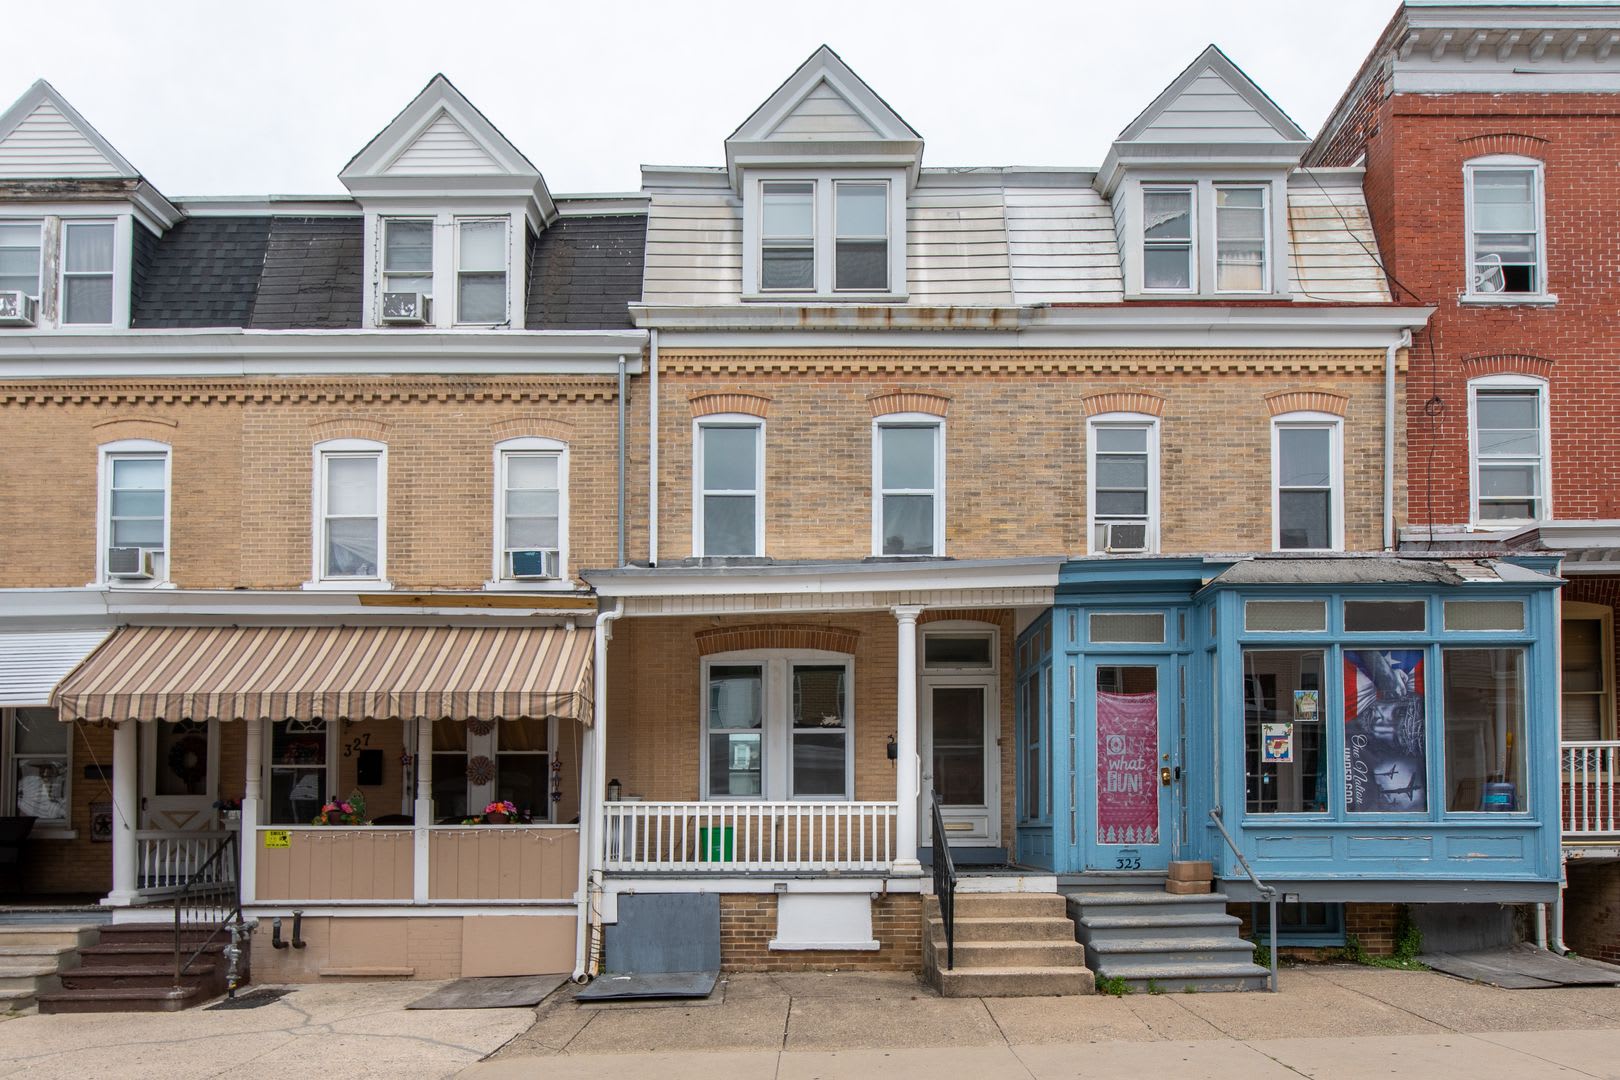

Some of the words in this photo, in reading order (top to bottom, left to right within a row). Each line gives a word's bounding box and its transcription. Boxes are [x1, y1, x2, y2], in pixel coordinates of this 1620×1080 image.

[344, 733, 371, 757] 327
[1352, 735, 1367, 757] One
[1109, 756, 1146, 770] what
[1354, 761, 1368, 803] Nation
[1115, 857, 1141, 870] 325
